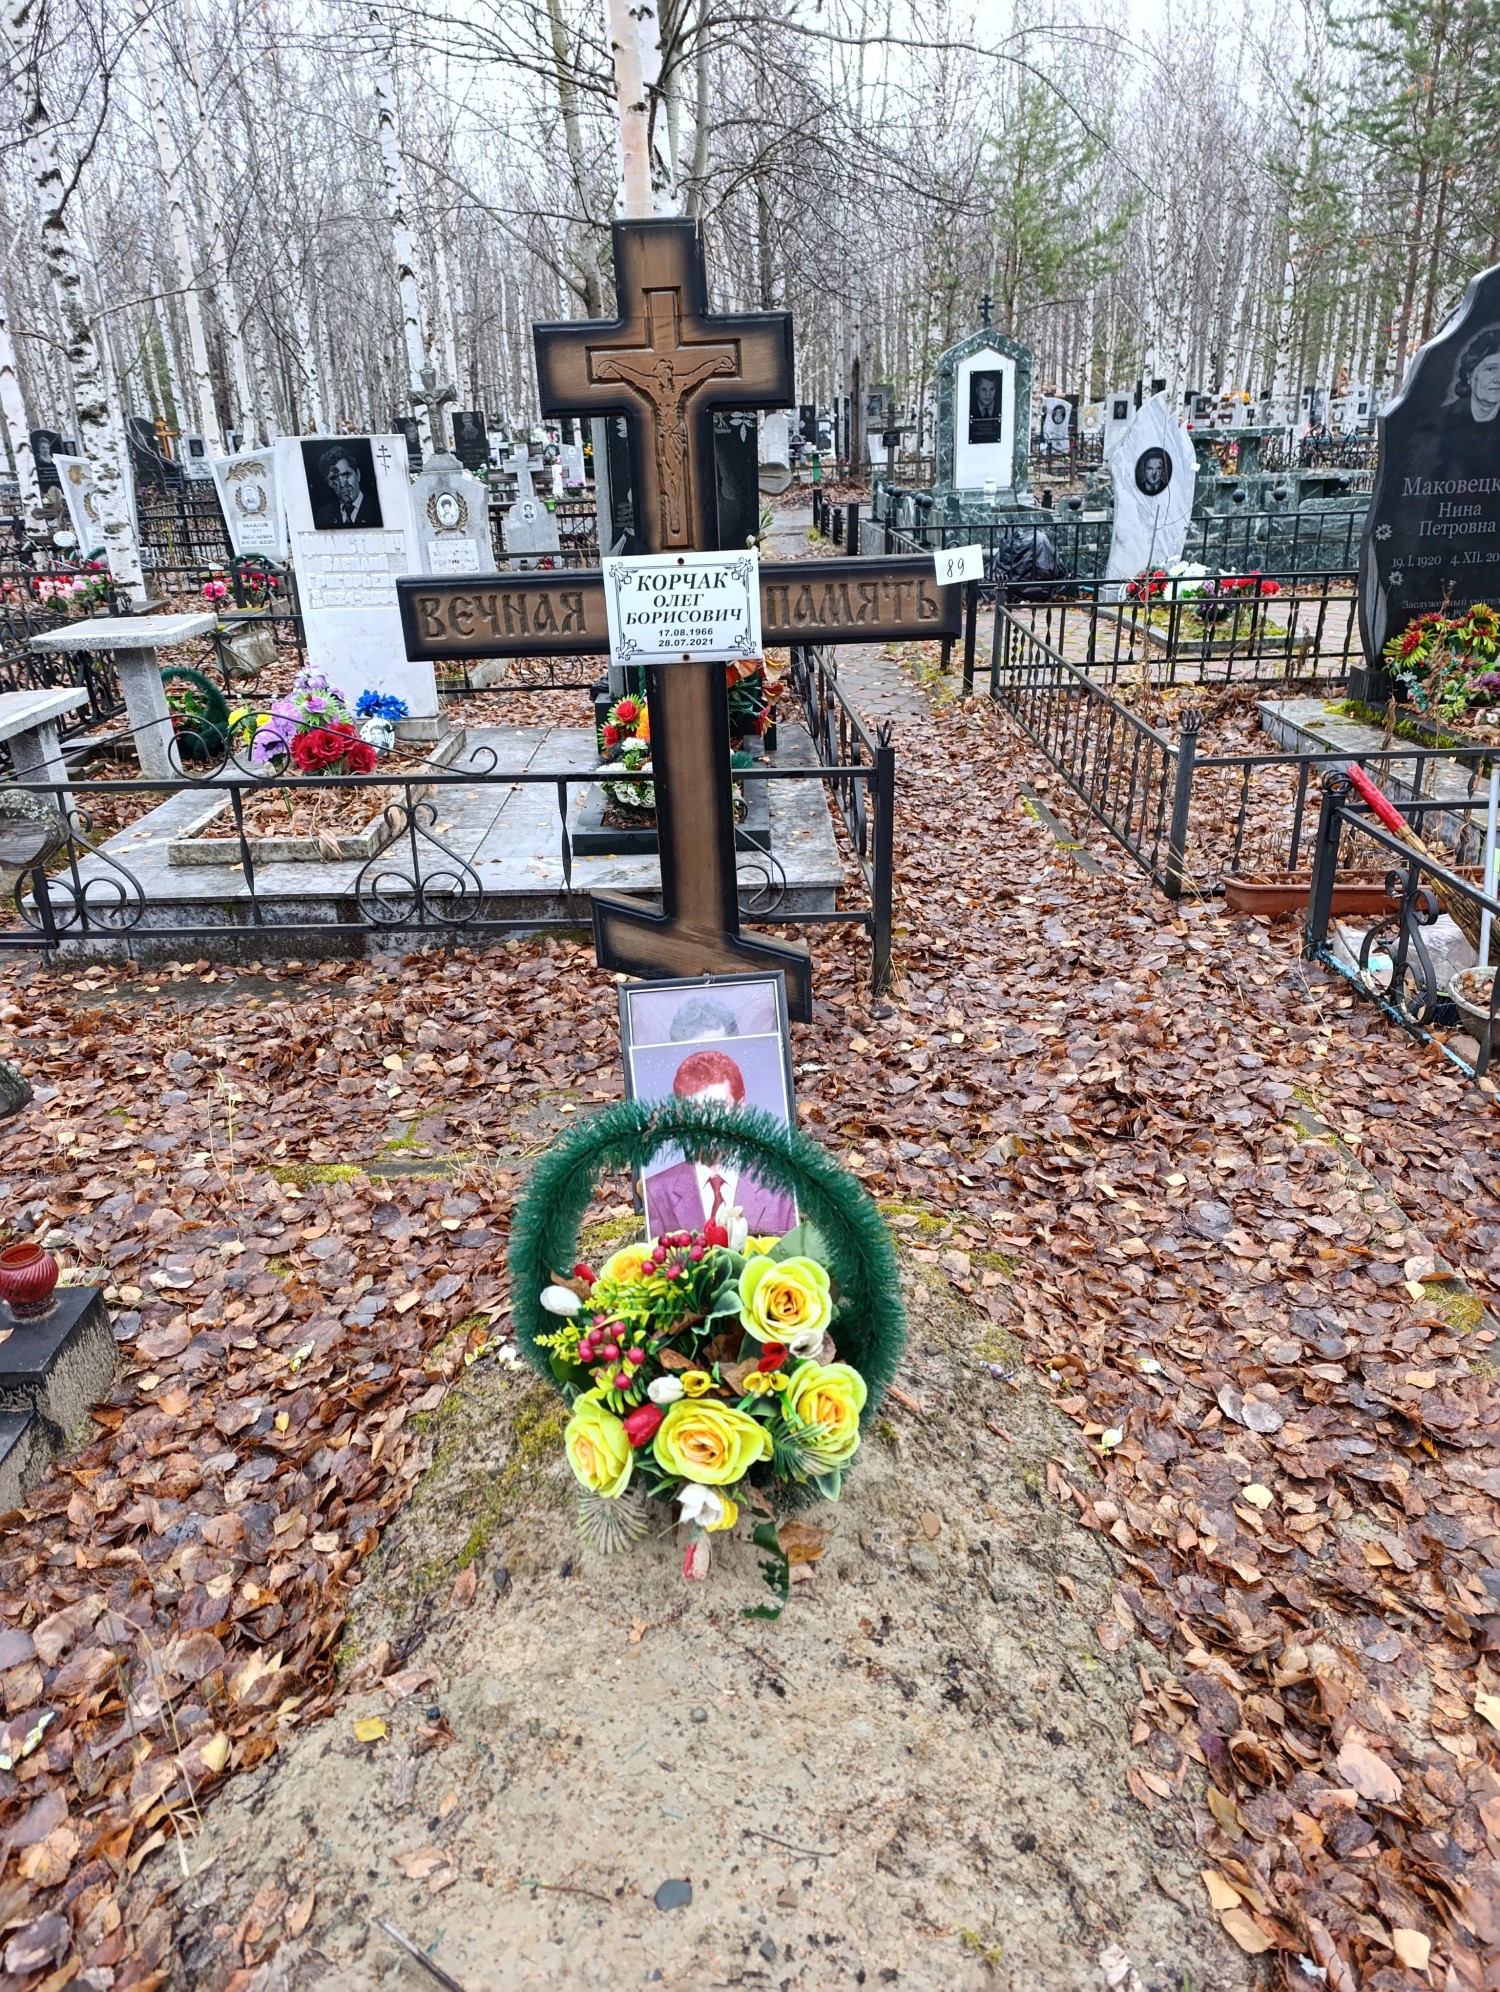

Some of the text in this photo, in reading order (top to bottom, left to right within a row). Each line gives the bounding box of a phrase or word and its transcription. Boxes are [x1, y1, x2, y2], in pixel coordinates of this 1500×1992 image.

[1437, 502, 1482, 518] Нина
[1418, 520, 1496, 539] Петровна
[946, 557, 965, 578] 89
[1416, 555, 1442, 569] 1920
[1450, 554, 1460, 567] 4.
[636, 572, 729, 592] КОРЧАК
[653, 593, 705, 607] ОЛЕГ
[1402, 597, 1467, 610] Заслуженый
[418, 579, 940, 640] ВЕЧНАЯ ПАМЯТЬ
[626, 608, 743, 625] БОРИСОВИЧ
[658, 627, 714, 637] 17.08.1966
[658, 638, 714, 647] 28.07.2021
